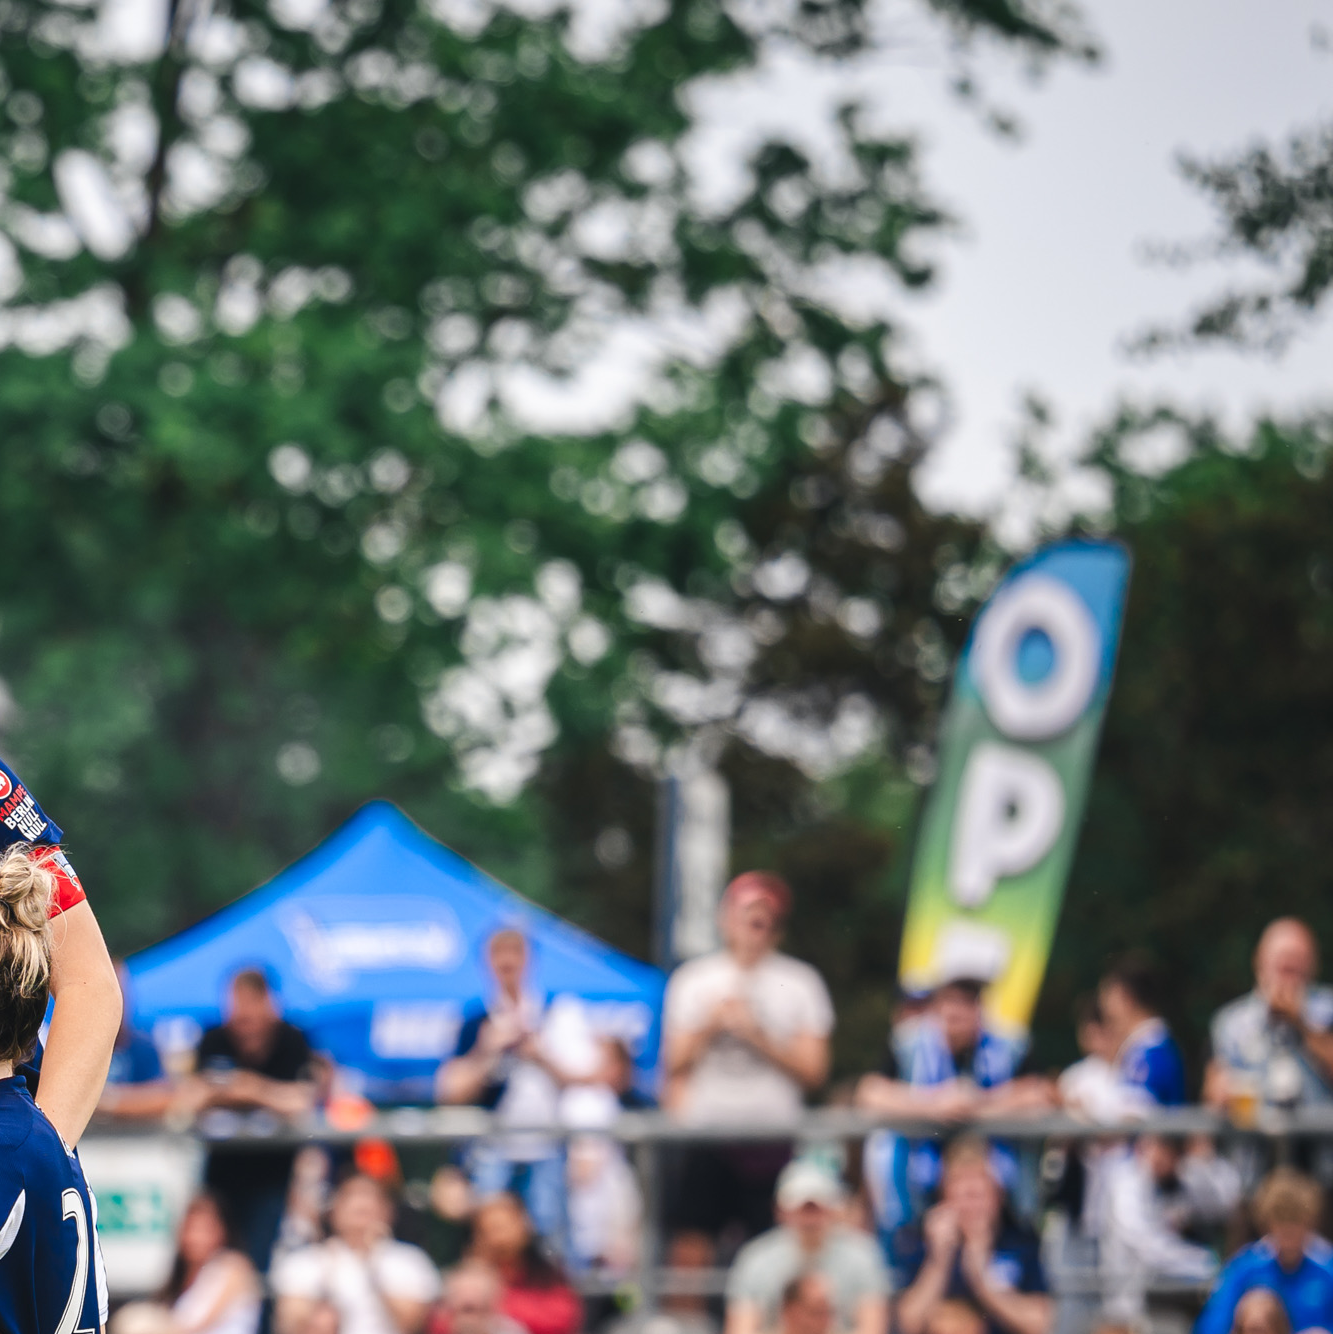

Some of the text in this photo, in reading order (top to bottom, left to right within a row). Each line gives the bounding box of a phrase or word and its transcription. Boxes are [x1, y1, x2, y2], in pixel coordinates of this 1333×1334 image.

[4, 794, 35, 830] BERLIN
[17, 809, 39, 833] NULL
[23, 821, 47, 842] NULL
